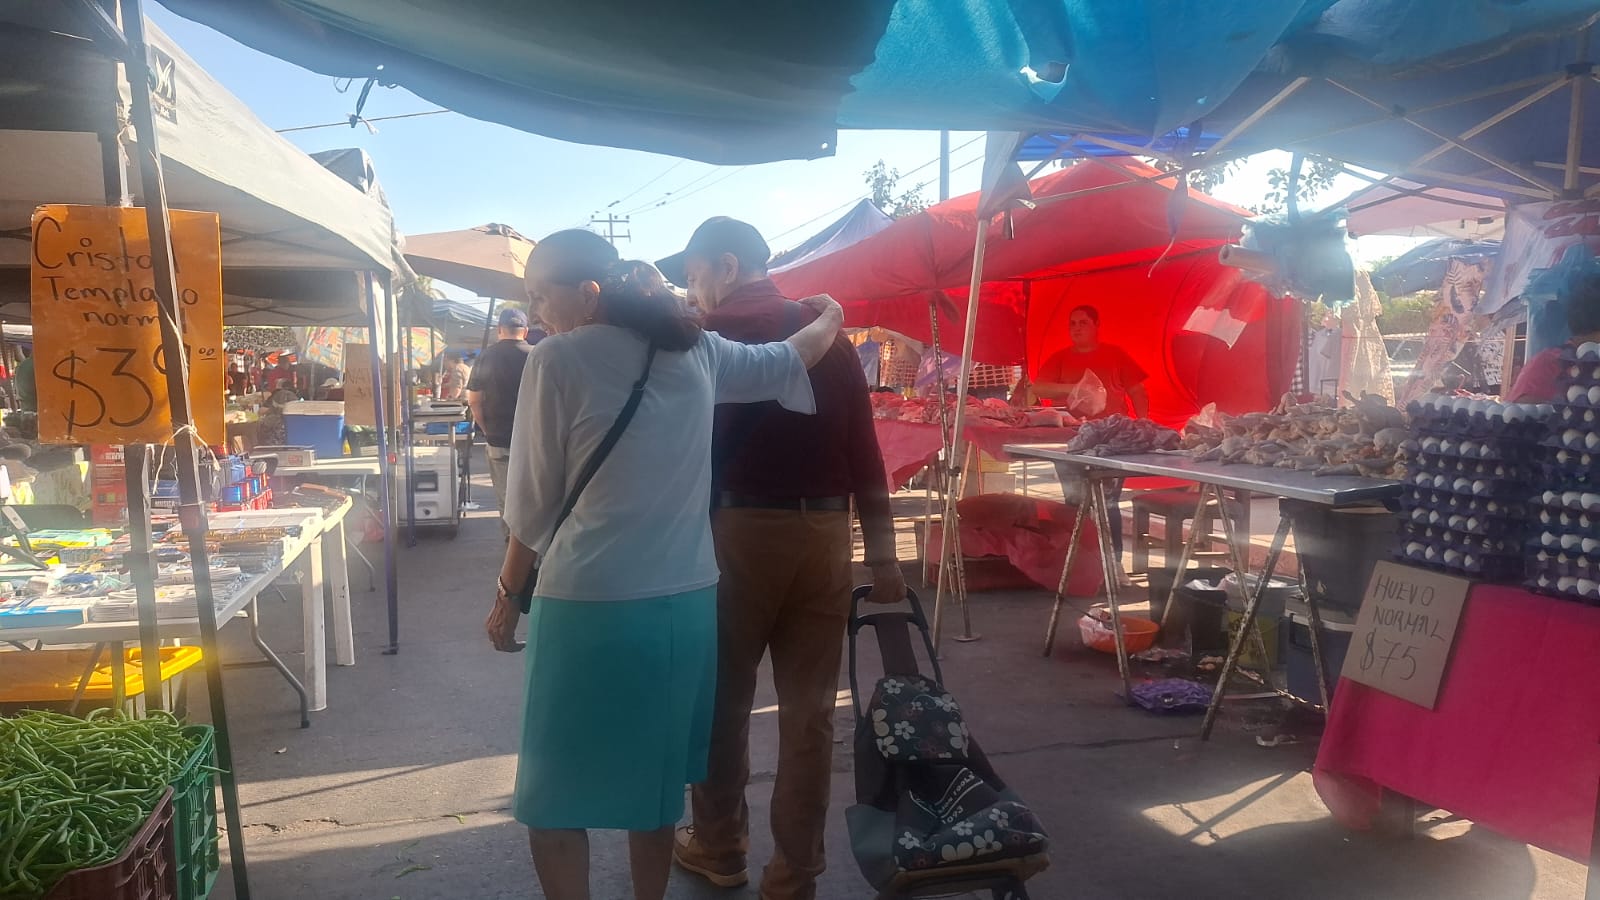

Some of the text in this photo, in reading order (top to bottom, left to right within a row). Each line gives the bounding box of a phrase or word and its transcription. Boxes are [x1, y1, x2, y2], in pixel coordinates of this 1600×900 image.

[42, 276, 198, 309] Templao
[83, 308, 187, 333] norml
[1373, 574, 1434, 606] HUEVO
[1373, 605, 1445, 641] NORMAL
[1360, 628, 1420, 681] $75
